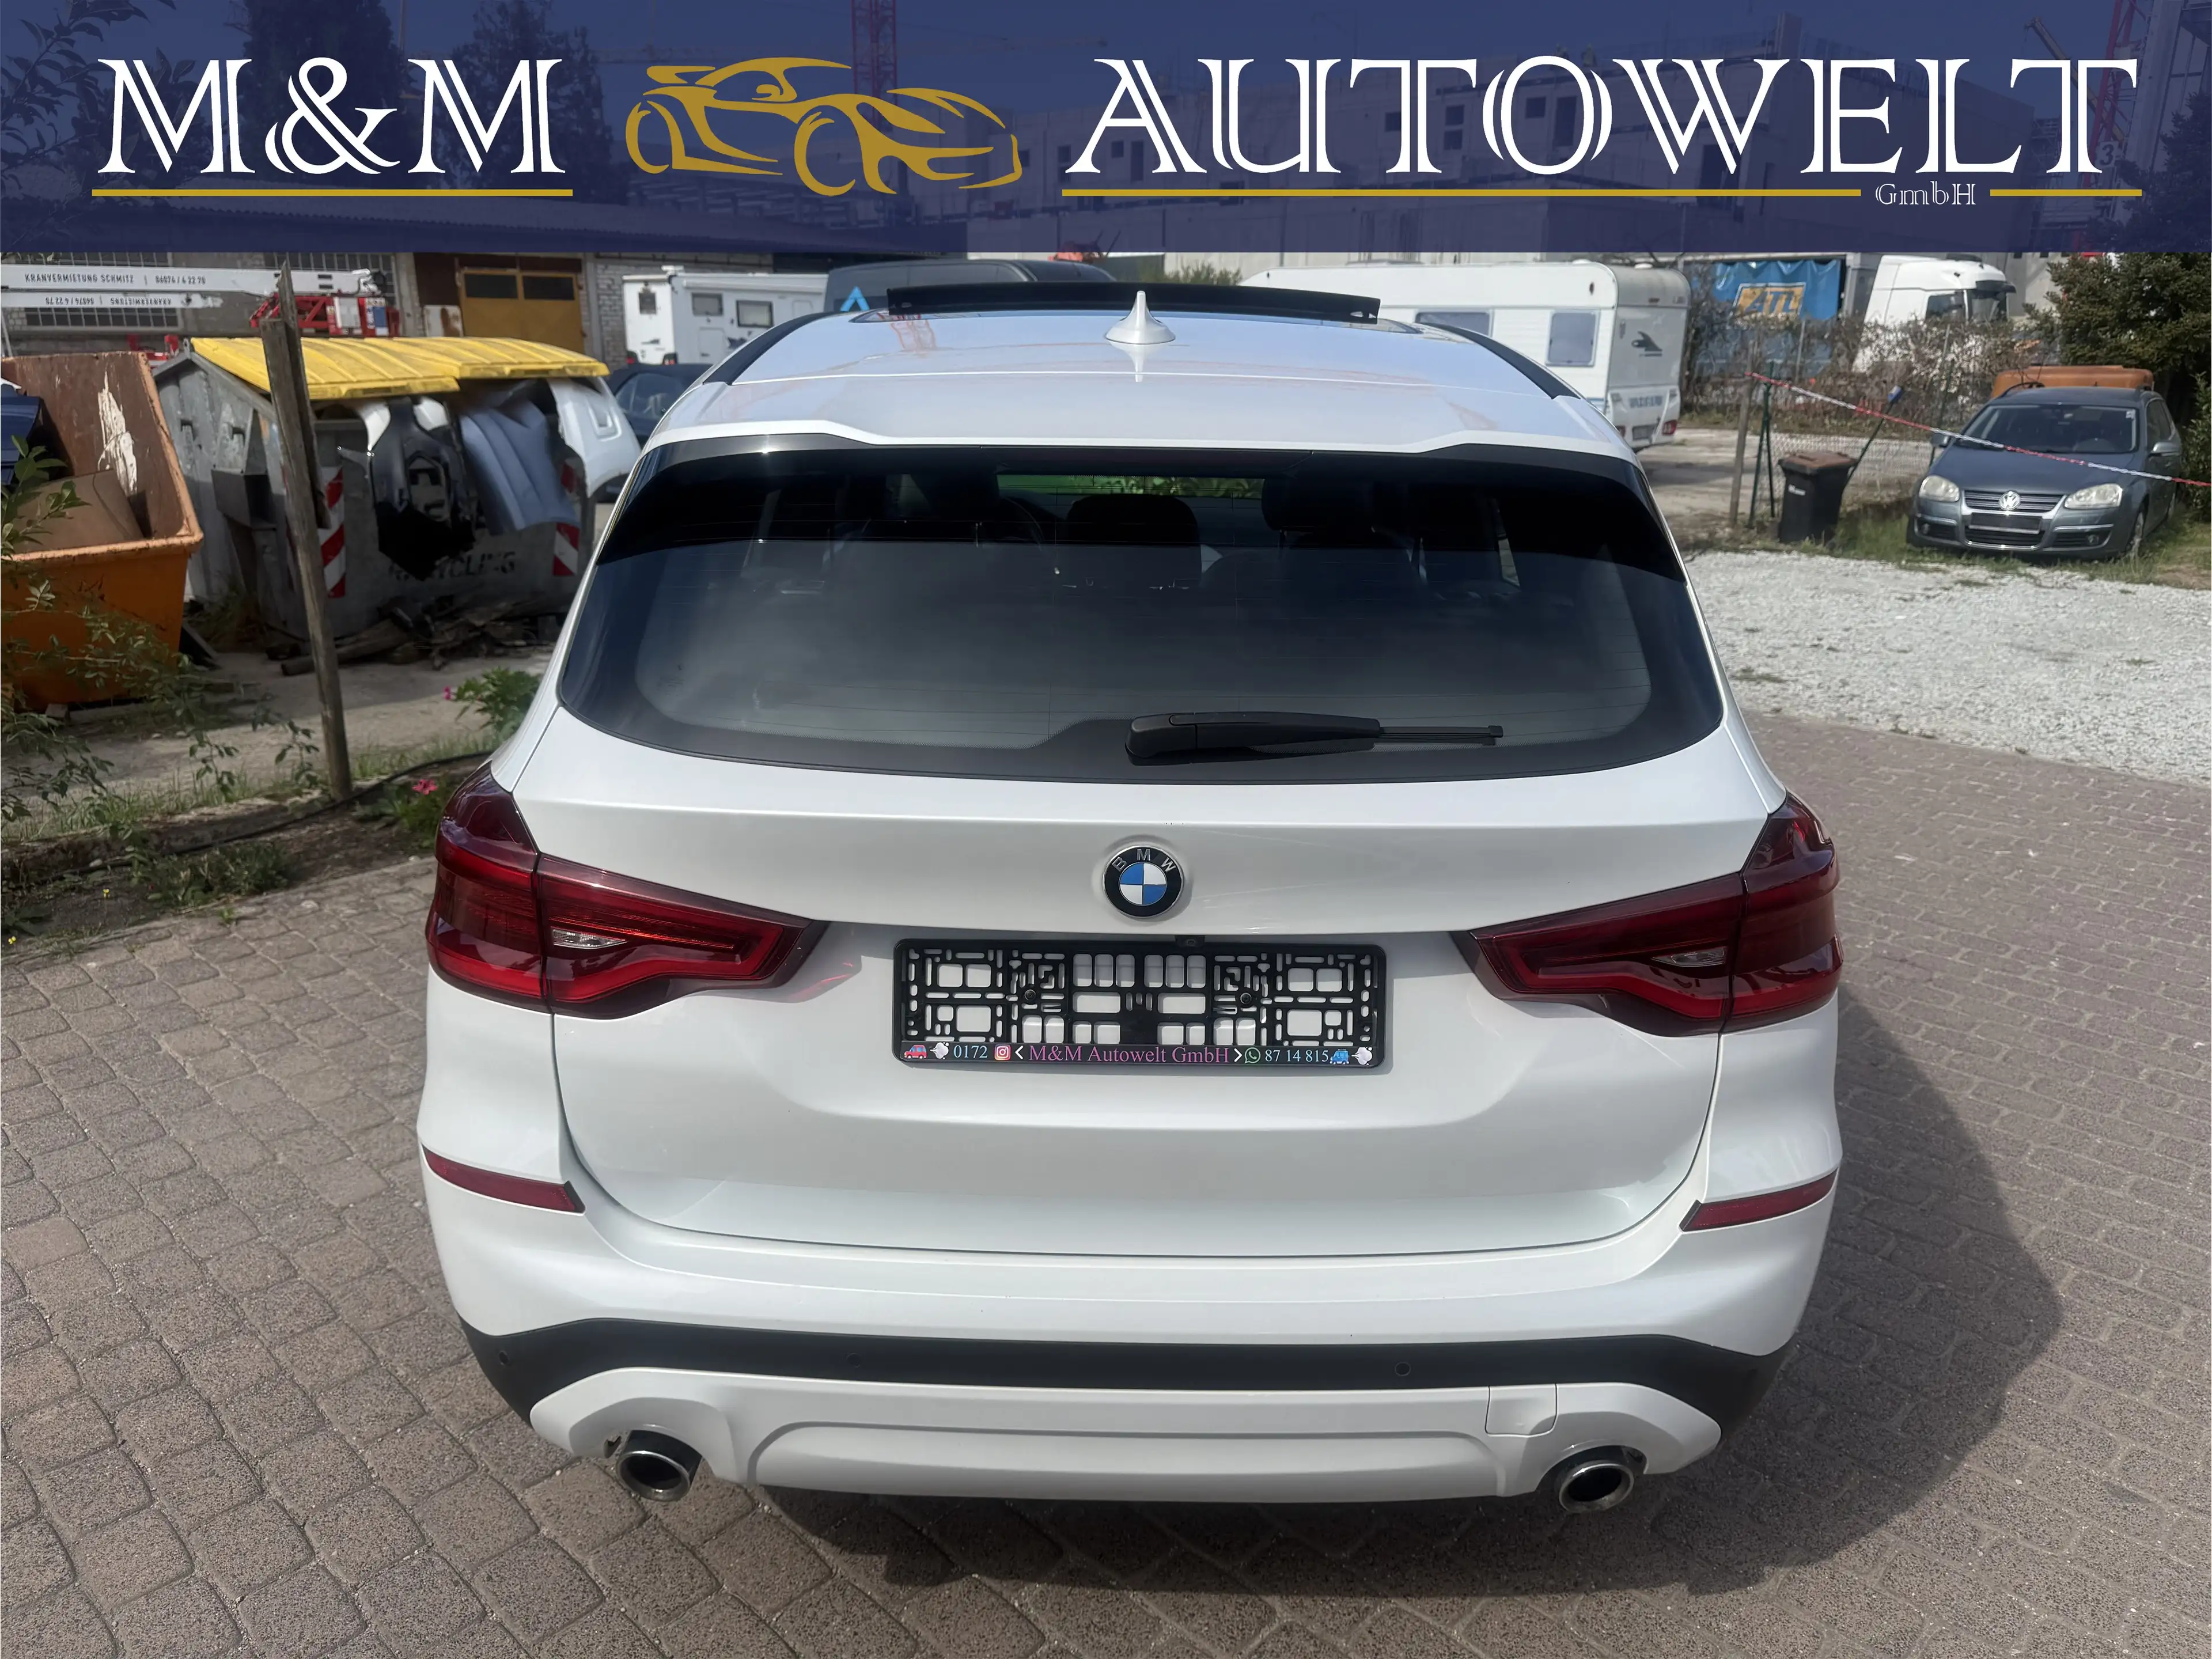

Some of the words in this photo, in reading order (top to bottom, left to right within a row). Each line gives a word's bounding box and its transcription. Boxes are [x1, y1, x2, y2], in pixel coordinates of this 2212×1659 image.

[2099, 143, 2115, 166] 3
[25, 273, 98, 283] KRANVERMIETUNG
[100, 274, 134, 284] SCHMITZ
[1112, 849, 1176, 873] BMW
[953, 1045, 988, 1059] 0172
[1029, 1045, 1082, 1061] M&M
[1087, 1046, 1166, 1063] Autowelt
[1172, 1047, 1229, 1063] GmbH
[1264, 1049, 1281, 1062] 87
[1286, 1049, 1301, 1062] 14
[1305, 1050, 1329, 1062] 815
